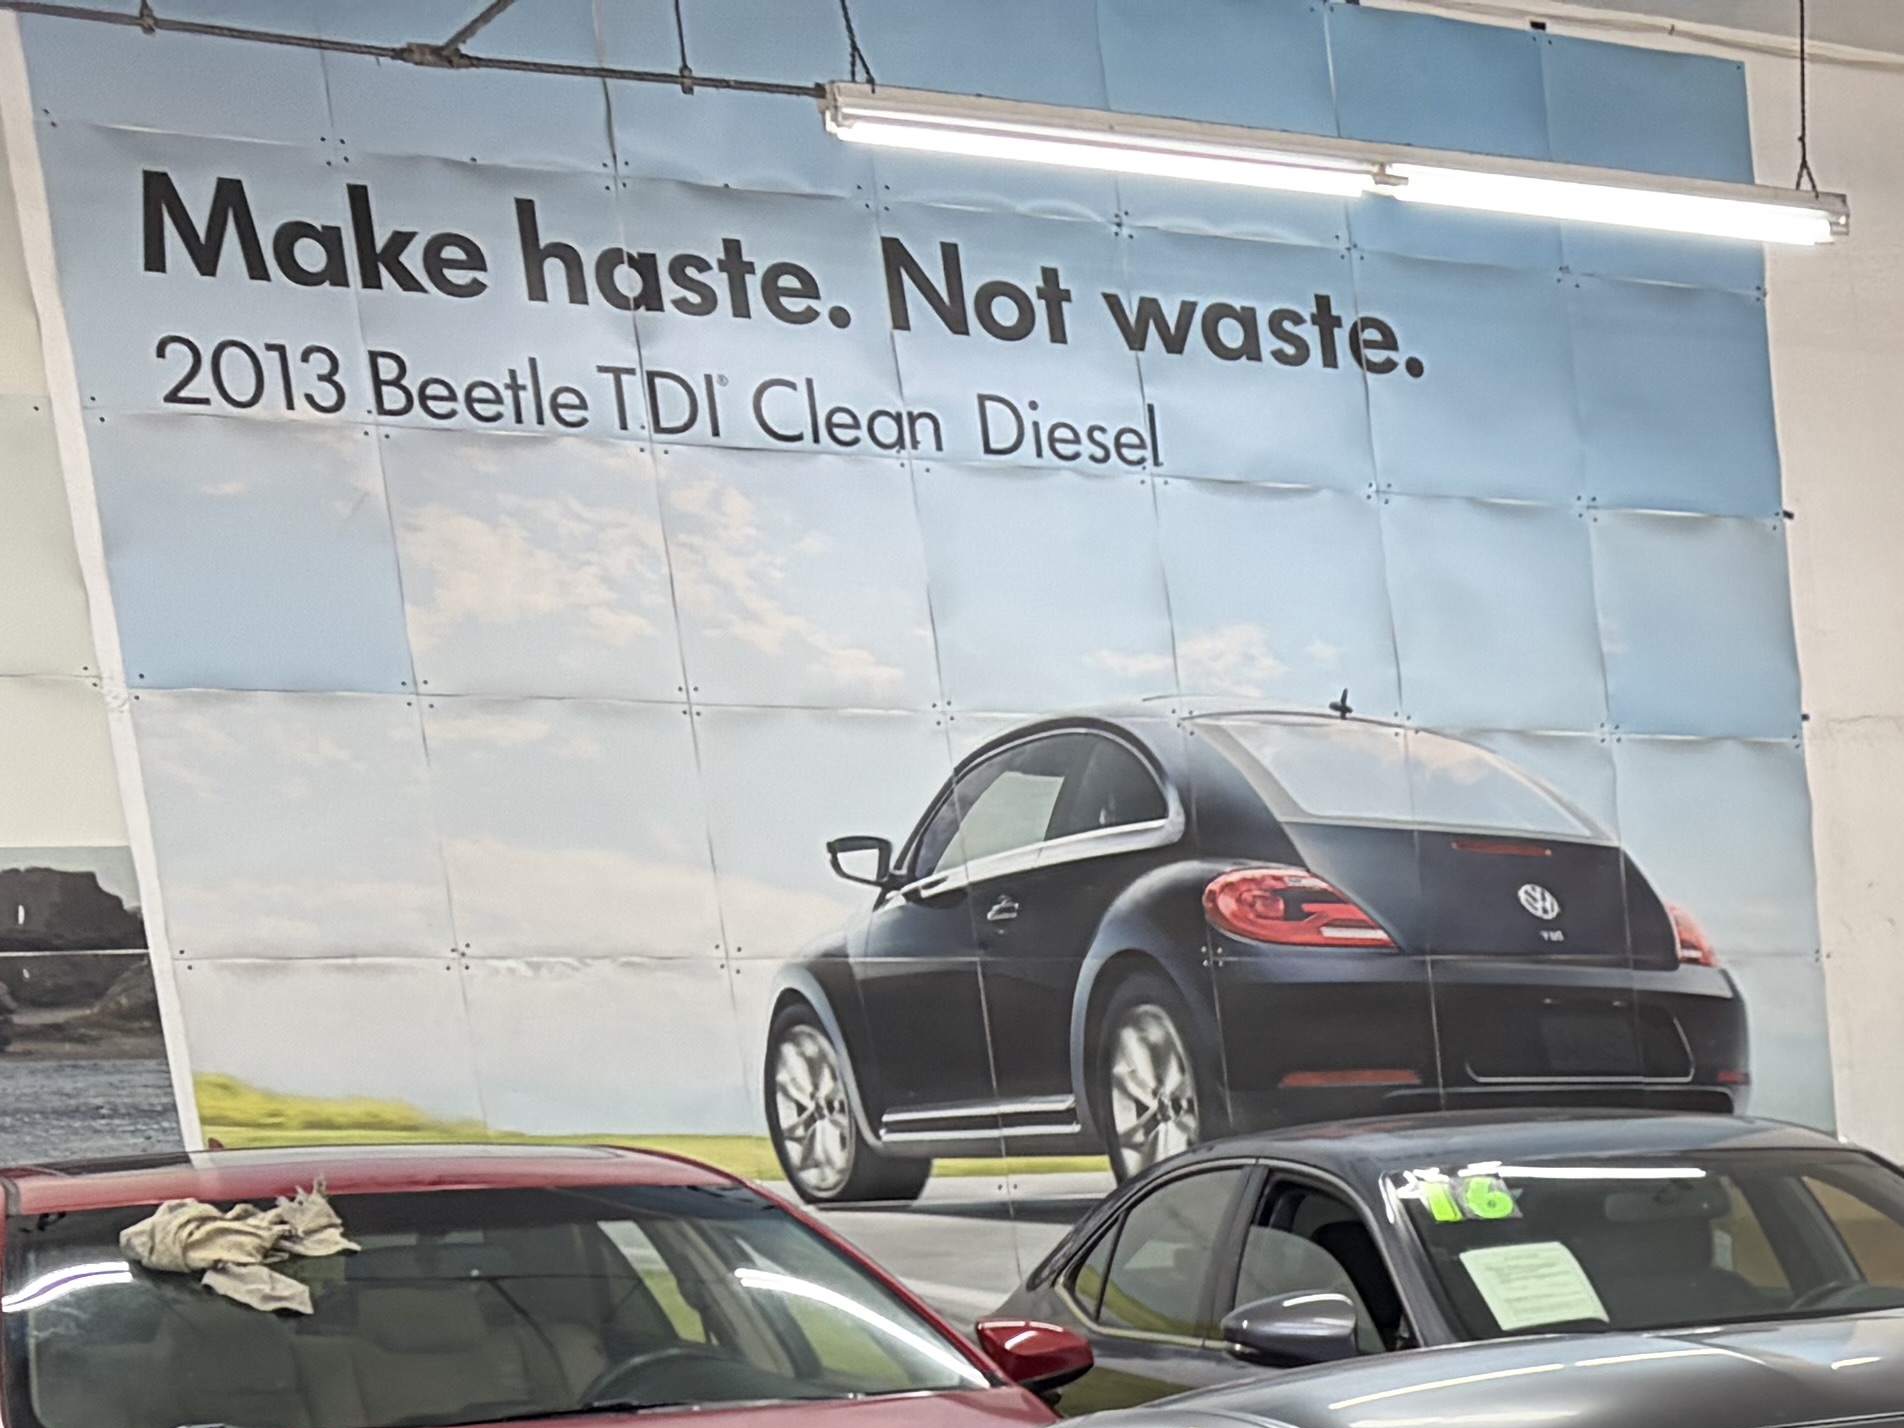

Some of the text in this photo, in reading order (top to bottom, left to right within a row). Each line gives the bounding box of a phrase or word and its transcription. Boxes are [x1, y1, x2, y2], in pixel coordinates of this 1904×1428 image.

[141, 170, 1426, 378] Make haste. Not waste.
[155, 335, 347, 416] 2013
[370, 352, 588, 433] Beetle
[752, 377, 941, 451] Clean
[980, 394, 1163, 471] Diesel
[1424, 1175, 1515, 1223] 16
